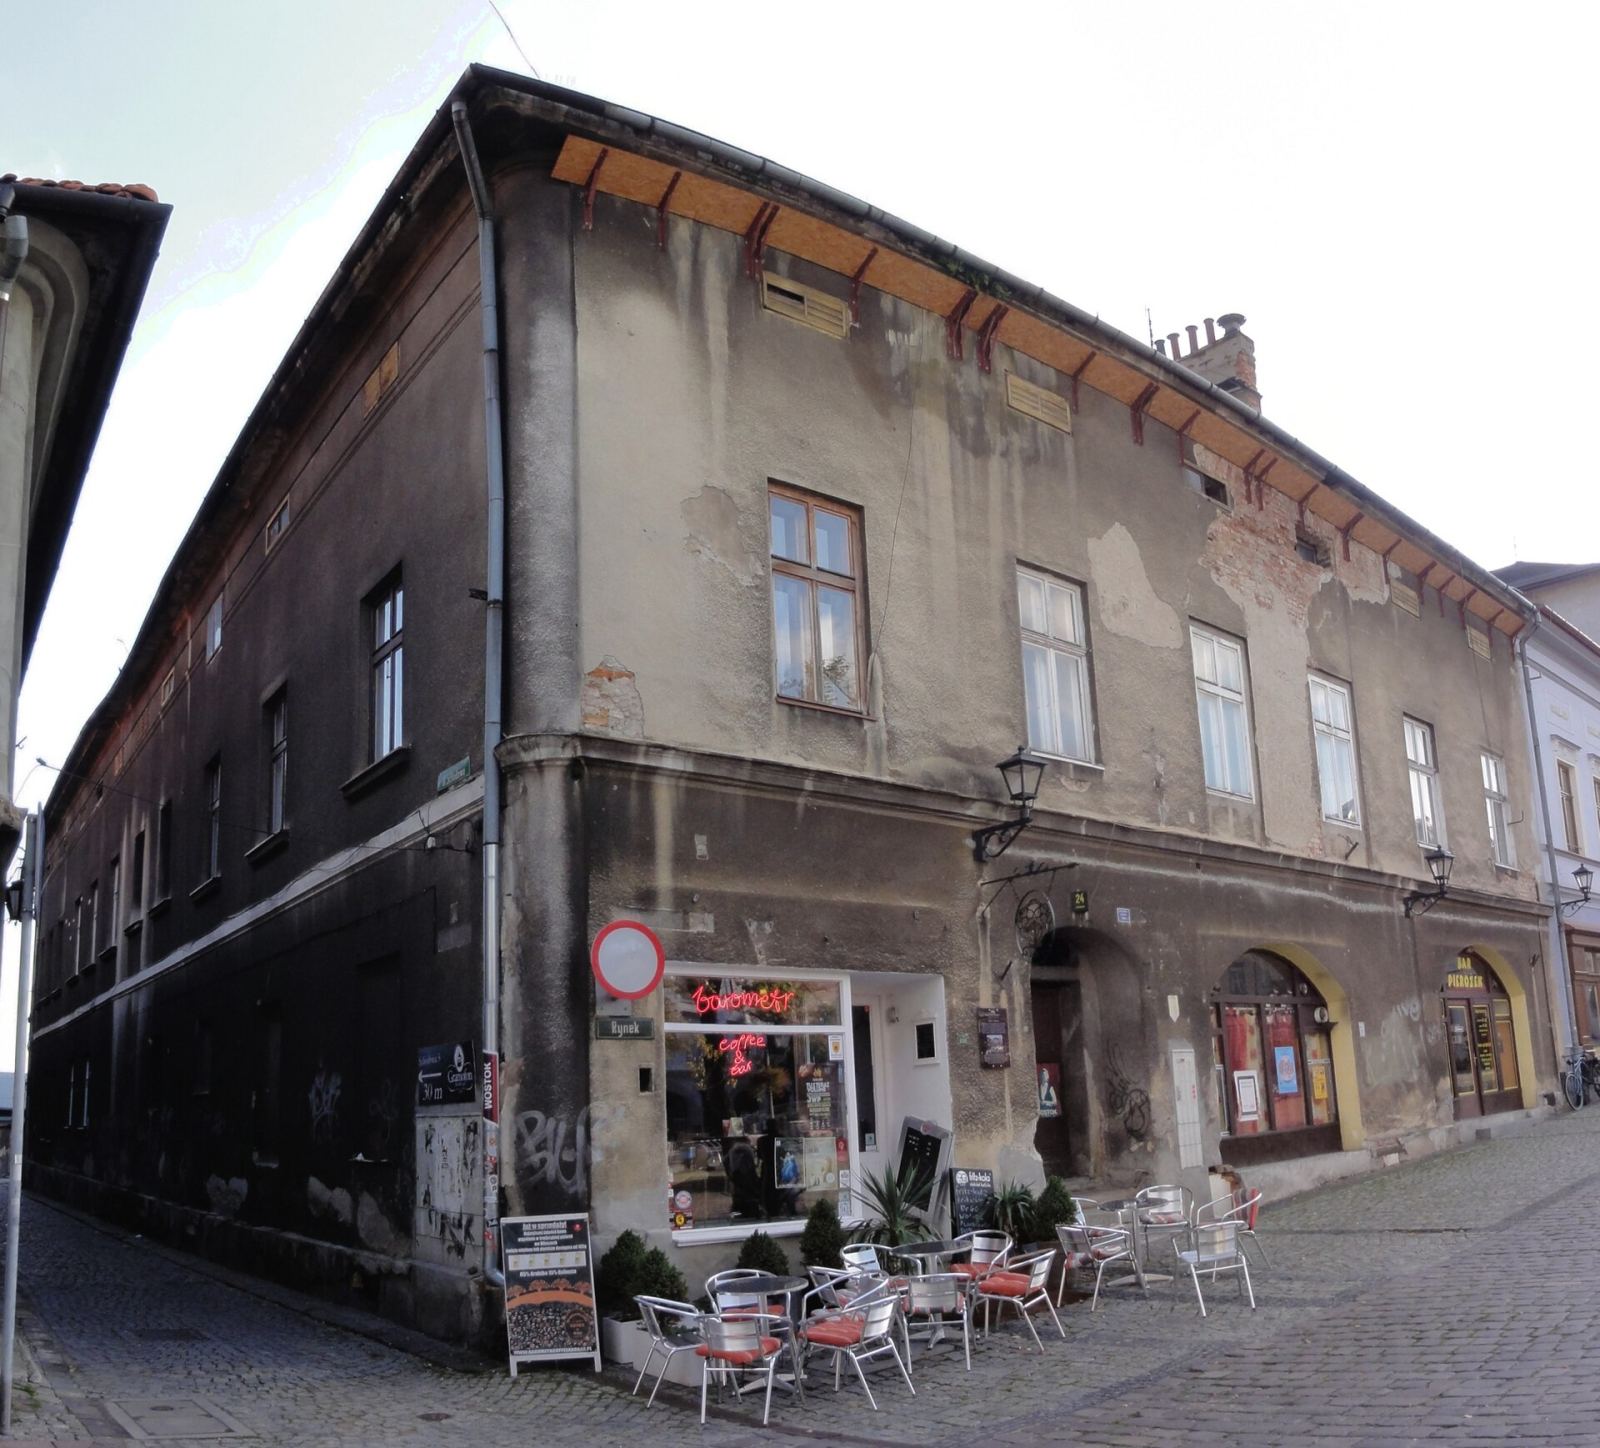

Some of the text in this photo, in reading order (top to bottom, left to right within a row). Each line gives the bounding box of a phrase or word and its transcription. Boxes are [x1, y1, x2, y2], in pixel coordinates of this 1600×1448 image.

[1457, 957, 1472, 969] BAR
[691, 985, 794, 1013] barometr
[611, 1021, 640, 1038] Rynek
[719, 1034, 767, 1051] coffee
[734, 1051, 744, 1065] &
[730, 1061, 752, 1076] bar
[423, 1083, 443, 1101] 30 m
[484, 1062, 493, 1110] WOSTOK
